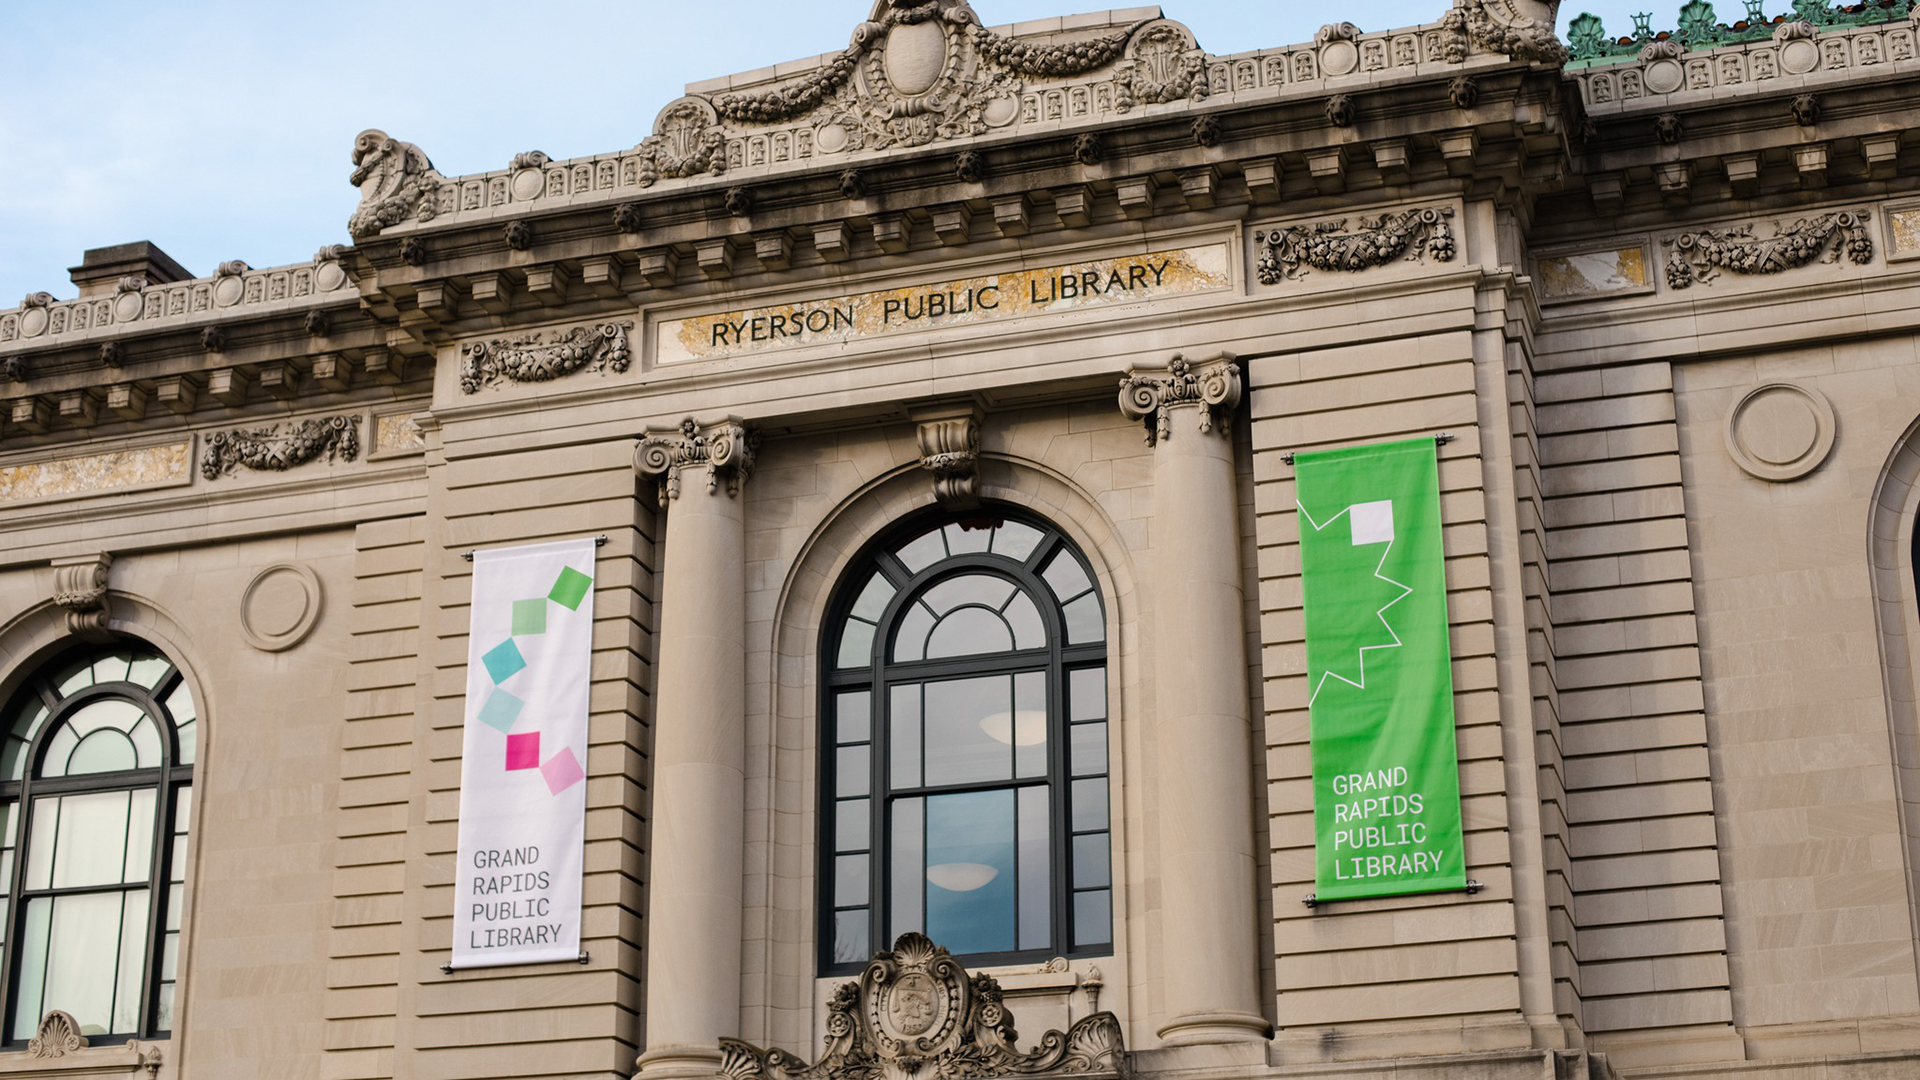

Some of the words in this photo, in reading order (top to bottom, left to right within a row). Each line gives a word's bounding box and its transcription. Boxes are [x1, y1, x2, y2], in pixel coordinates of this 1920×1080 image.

[711, 304, 853, 346] RYERSON
[884, 285, 999, 324] PUBLIC
[1031, 259, 1170, 304] LIBRARY
[1332, 766, 1408, 795] GRAND
[1334, 793, 1424, 824] RAPIDS
[1334, 822, 1427, 851] PUBLIC
[473, 846, 540, 869] GRAND
[1335, 850, 1444, 880] LIBRARY
[472, 871, 550, 895] RAPIDS
[471, 897, 550, 922] PUBLIC
[470, 923, 562, 949] LIBRARY
